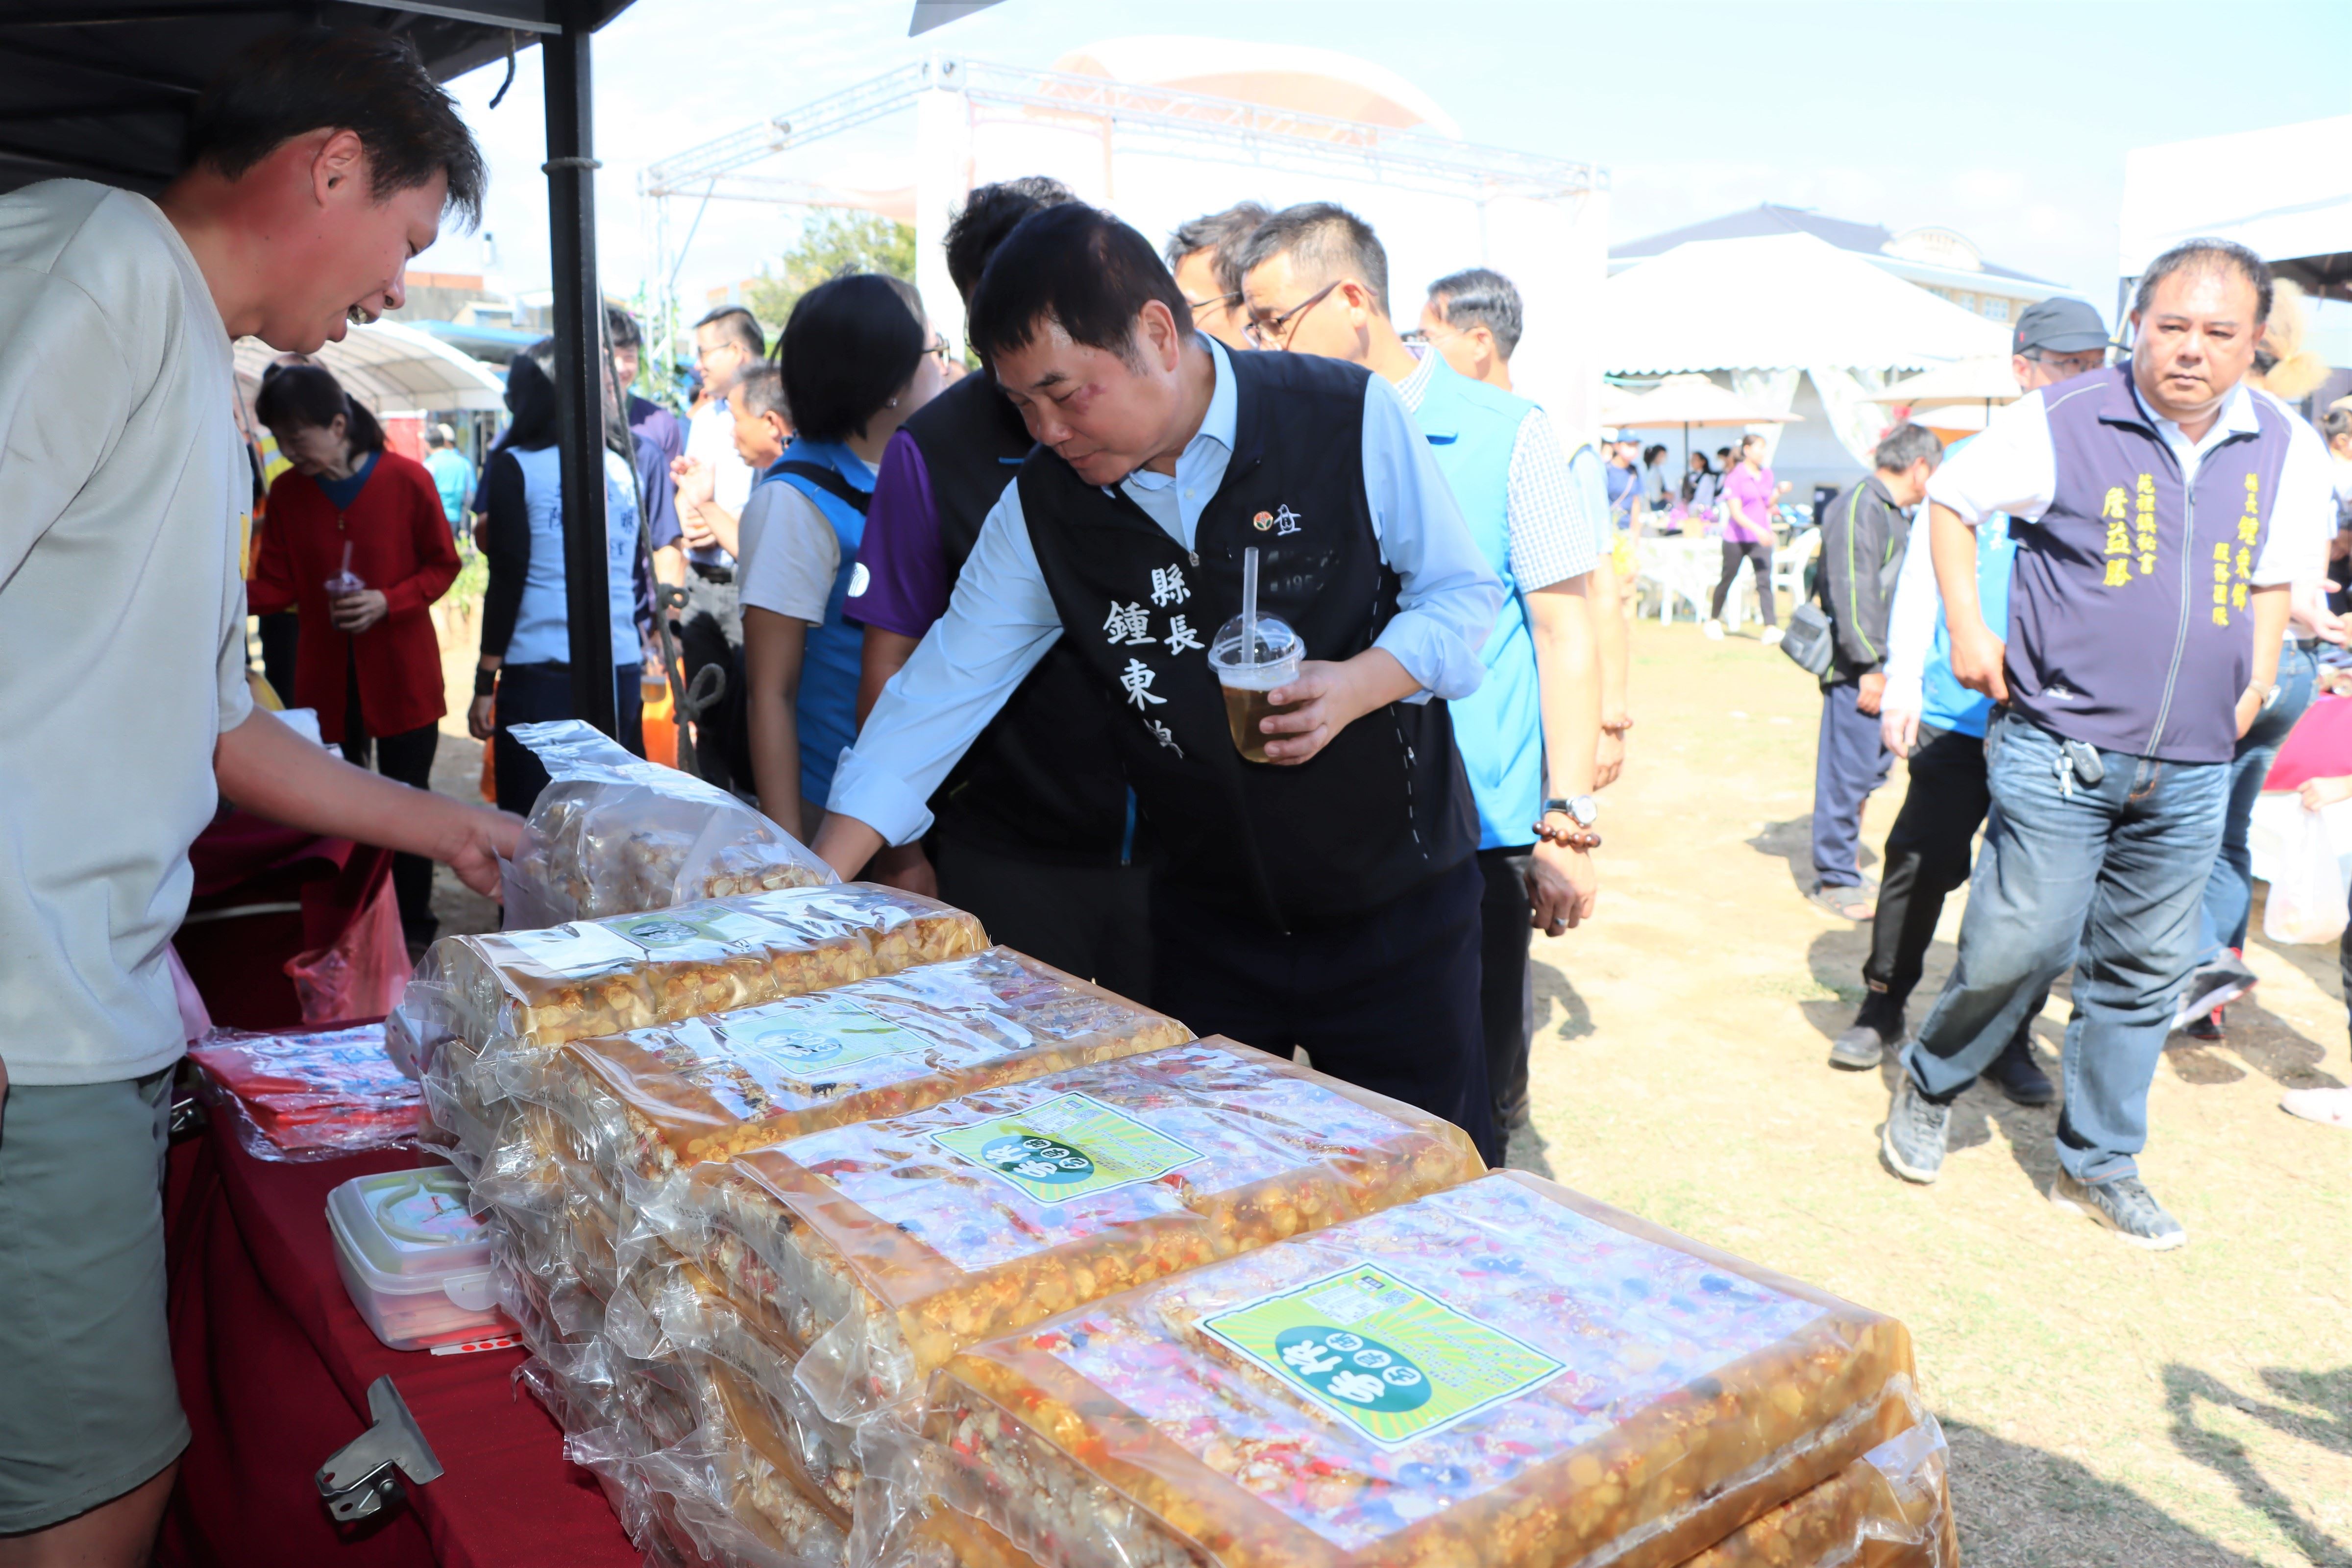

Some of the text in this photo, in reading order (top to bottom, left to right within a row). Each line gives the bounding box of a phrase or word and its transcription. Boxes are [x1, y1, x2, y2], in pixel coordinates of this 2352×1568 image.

[2102, 487, 2132, 587] 詹益勝
[1151, 563, 1205, 656] 縣長
[985, 1144, 1058, 1178] 手作
[1025, 1139, 1089, 1169] 古早味
[1282, 1340, 1386, 1403] 手作
[1328, 1333, 1418, 1383] 古早味
